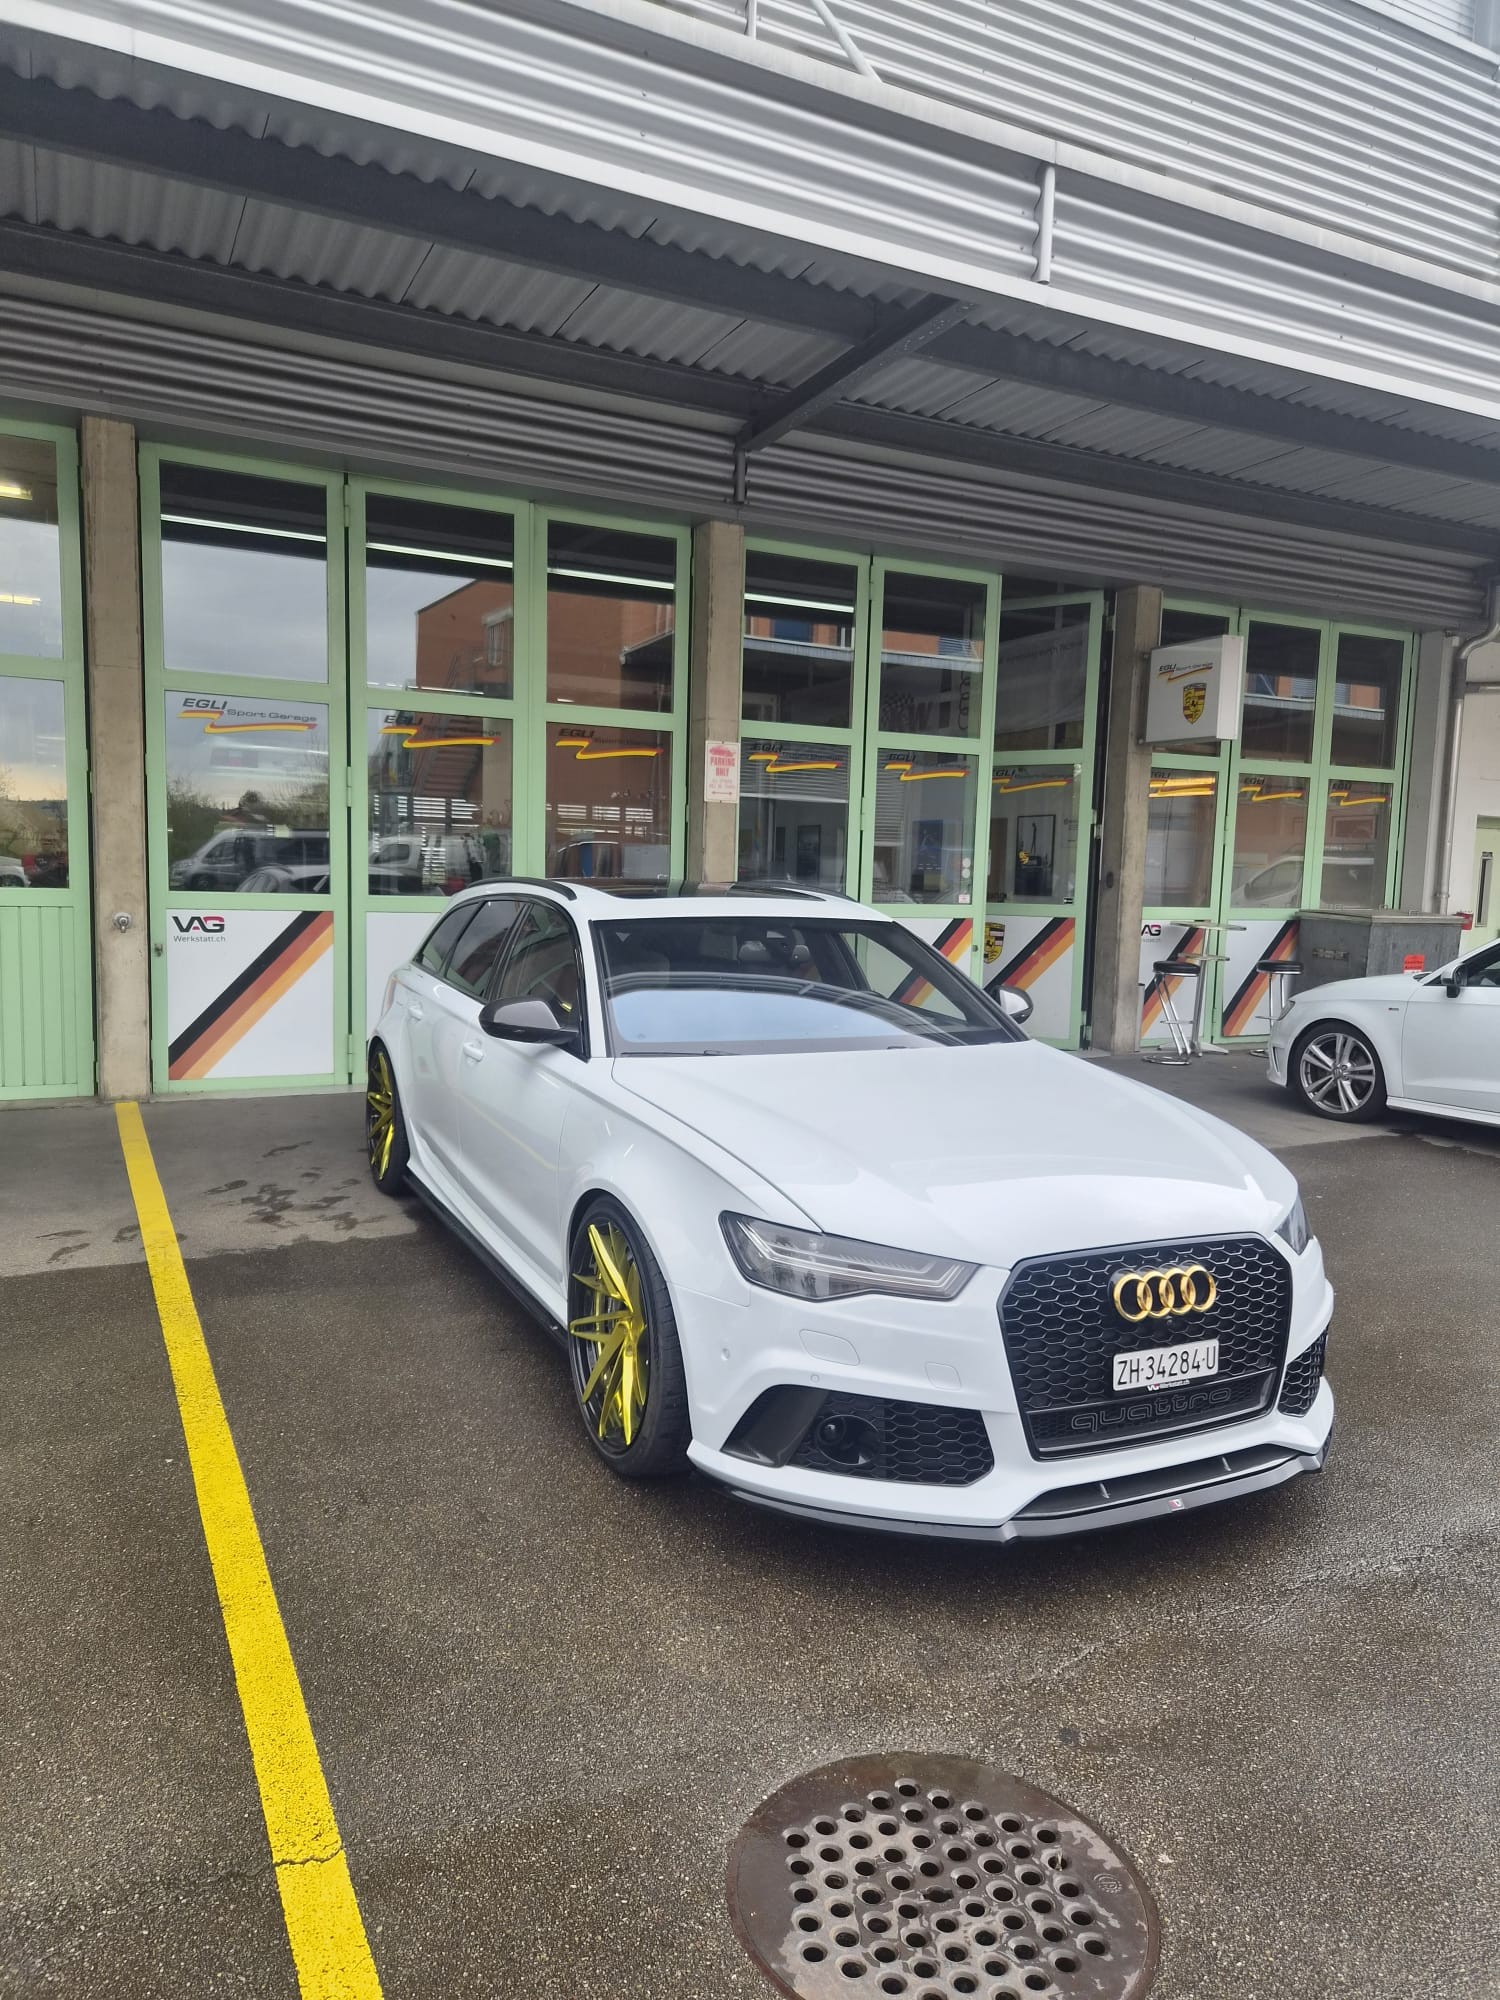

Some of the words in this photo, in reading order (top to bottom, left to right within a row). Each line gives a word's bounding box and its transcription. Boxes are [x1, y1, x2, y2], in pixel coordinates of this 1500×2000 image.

[182, 698, 228, 710] EGLI
[227, 709, 267, 718] Sport
[269, 712, 317, 721] Garage
[384, 715, 424, 725] EGLI
[559, 728, 595, 738] EGLI
[710, 756, 735, 767] PARKING
[715, 767, 729, 776] ONLY
[171, 916, 225, 933] VAG
[1141, 924, 1162, 937] AG
[1071, 1387, 1232, 1433] quattro
